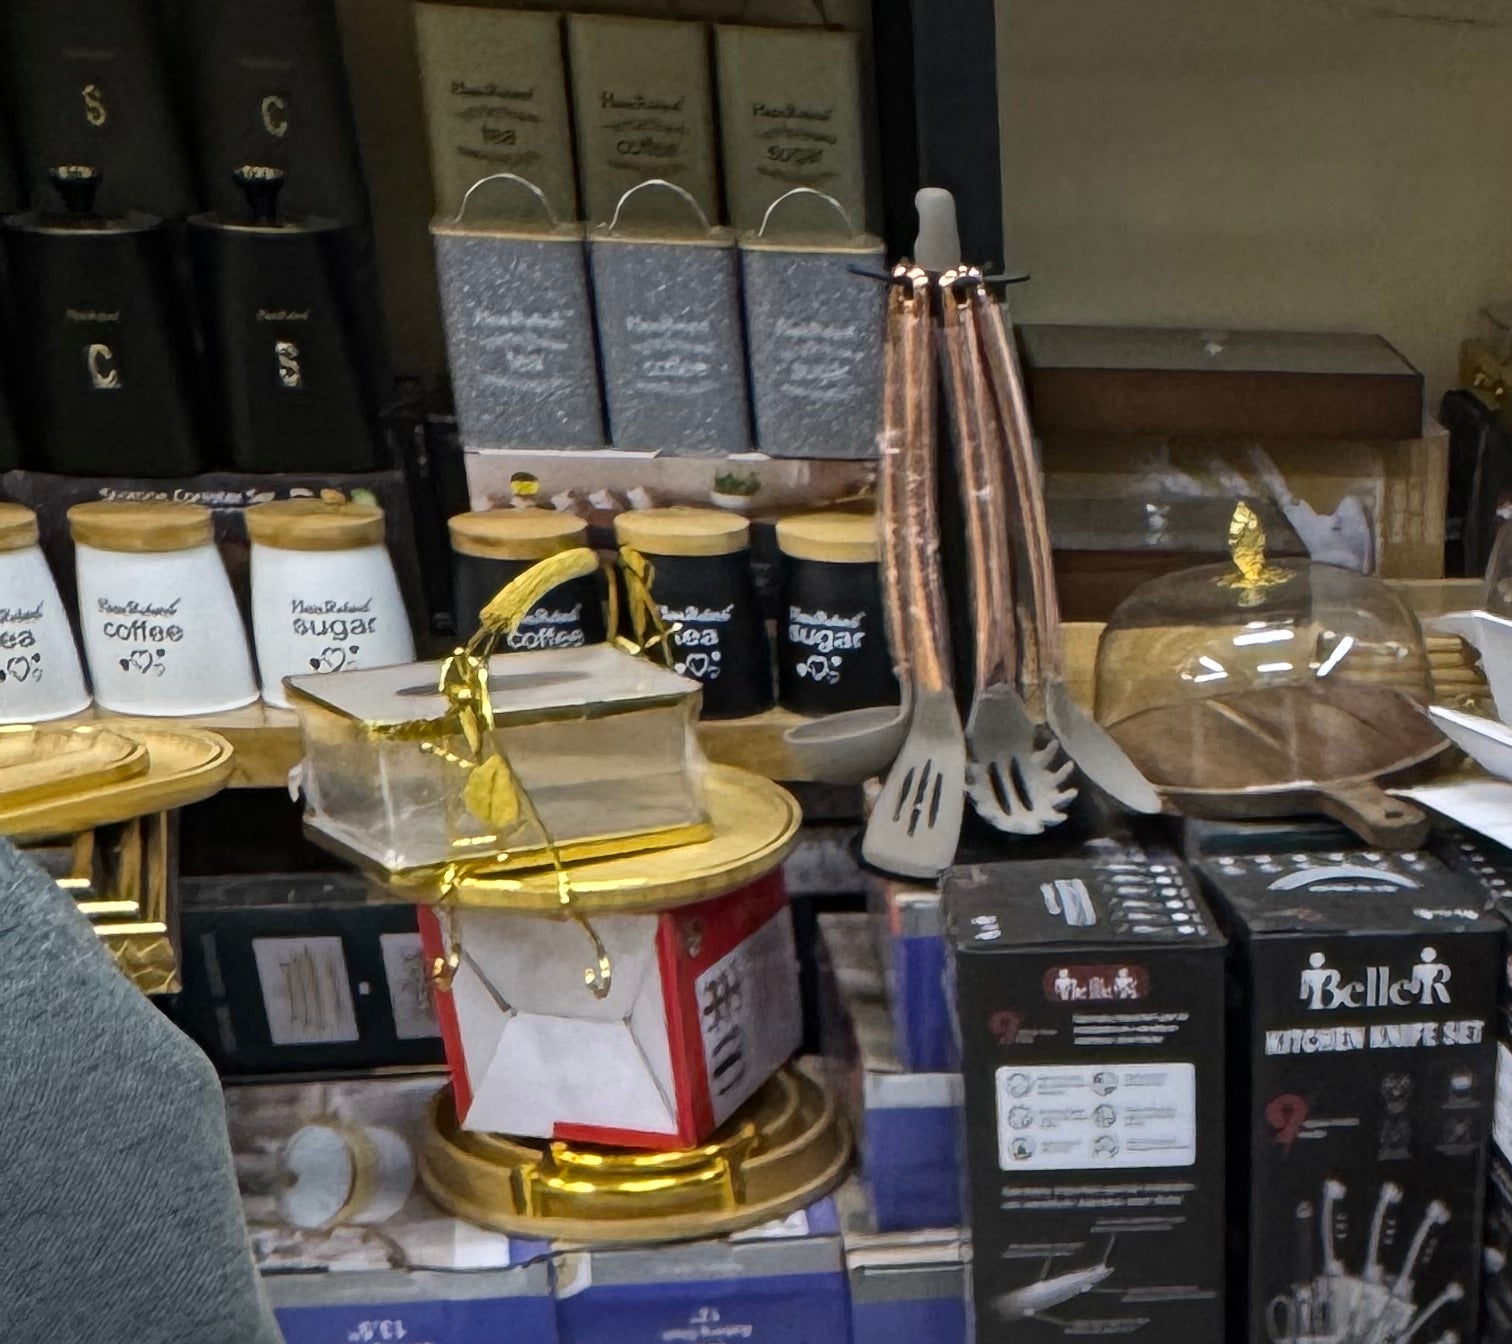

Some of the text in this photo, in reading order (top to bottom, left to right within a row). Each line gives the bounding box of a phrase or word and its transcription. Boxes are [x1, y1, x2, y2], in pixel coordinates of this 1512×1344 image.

[261, 95, 289, 138] C
[103, 620, 184, 642] coffee
[292, 617, 377, 641] sugar
[507, 627, 585, 650] coffee
[1443, 1019, 1486, 1046] SET
